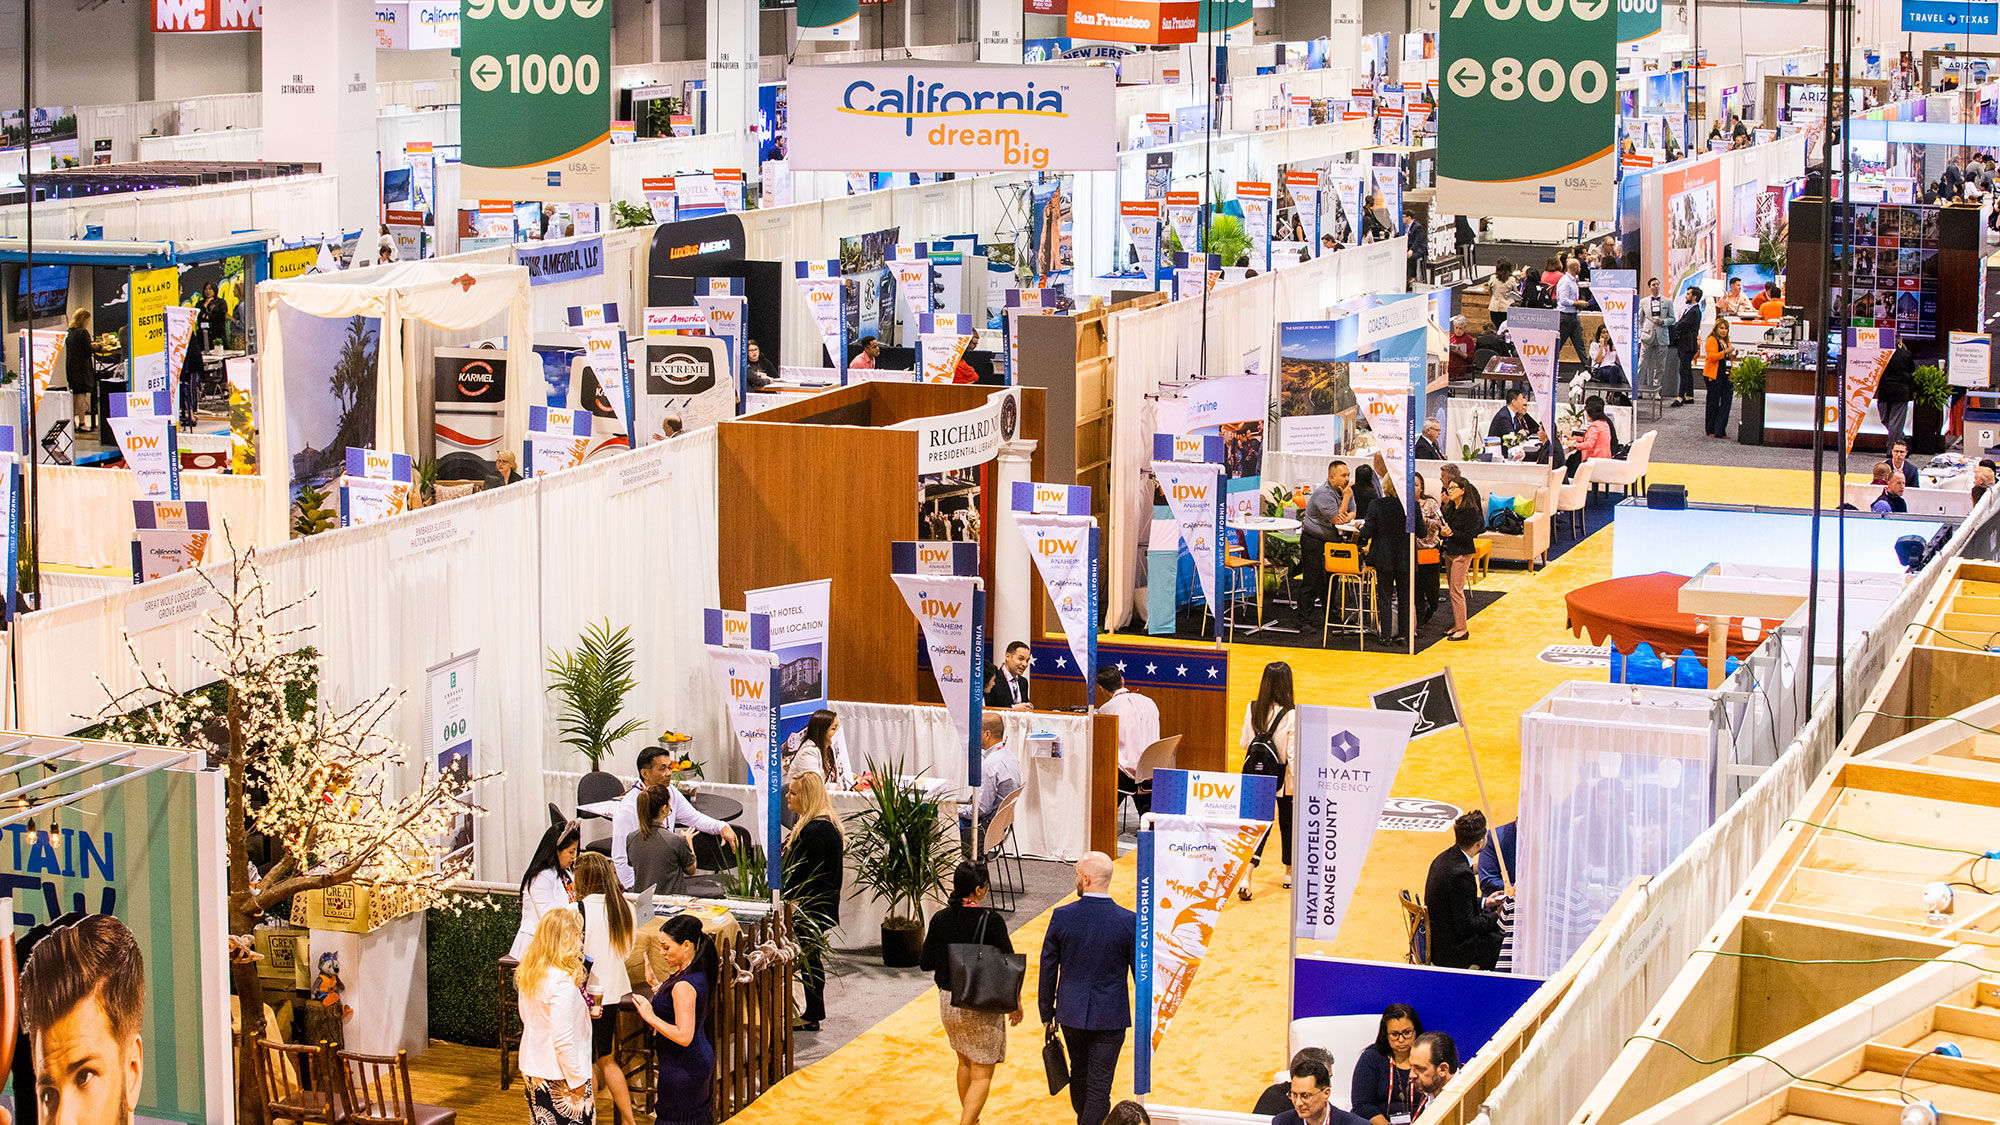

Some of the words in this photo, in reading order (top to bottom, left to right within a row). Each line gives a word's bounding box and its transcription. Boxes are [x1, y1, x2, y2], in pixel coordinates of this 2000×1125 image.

[1074, 12, 1095, 26] San
[1097, 13, 1150, 30] Francisco
[1162, 17, 1172, 29] San
[1173, 17, 1196, 29] Francisco
[1910, 13, 1944, 23] TRAVEL
[1959, 15, 1989, 24] TEXAS
[720, 53, 730, 61] FIRE
[1063, 48, 1091, 59] NEW
[292, 74, 303, 84] FIRE
[506, 54, 599, 95] 1000
[1489, 57, 1608, 104] 800
[281, 84, 315, 94] EXTINGUISHER
[843, 75, 1063, 136] California
[928, 124, 1020, 147] dream
[1003, 142, 1049, 169] big
[568, 163, 588, 172] USA
[1564, 178, 1588, 188] USA
[542, 251, 583, 275] AMERICA,
[584, 246, 599, 268] LLC
[138, 281, 171, 294] OAKLAND
[810, 291, 834, 303] ipw
[1605, 301, 1627, 312] ipw
[648, 314, 667, 323] Tour
[711, 310, 735, 322] ipw
[148, 328, 162, 339] 2019
[1858, 331, 1877, 340] ipw
[588, 339, 613, 351] ipw
[1523, 344, 1549, 357] ipw
[654, 364, 706, 374] EXTREME
[148, 377, 165, 389] BEST
[458, 373, 494, 383] KARMEL
[129, 397, 151, 408] ipw
[1197, 401, 1218, 412] irvine
[1369, 402, 1399, 416] ipw
[549, 413, 571, 424] ipw
[930, 419, 989, 447] RICHARD
[127, 435, 159, 451] ipw
[1176, 440, 1200, 451] ipw
[928, 446, 977, 462] PRESIDENTIAL
[367, 457, 389, 468] ipw
[1037, 490, 1065, 503] ipw
[1173, 485, 1207, 500] ipw
[157, 507, 182, 520] ipw
[1039, 538, 1078, 556] ipw
[919, 550, 949, 563] ipw
[144, 600, 160, 612] GREAT
[160, 596, 173, 608] WOLF
[174, 593, 190, 604] LODGE
[921, 599, 962, 619] ipw
[158, 607, 174, 619] GROVE
[174, 600, 198, 615] ANAHEIM
[777, 605, 804, 617] HOTELS,
[725, 619, 748, 634] ipw
[786, 620, 823, 633] LOCATION
[932, 622, 963, 630] ANAHEIM
[930, 645, 966, 656] California
[974, 624, 983, 678] CALIFORNIA
[730, 678, 764, 700] ipw
[1318, 767, 1371, 782] HYATT
[1192, 782, 1235, 801] ipw
[1318, 780, 1371, 793] REGENCY
[1204, 802, 1237, 810] ANAHEIM
[1309, 796, 1320, 815] OF
[1325, 798, 1337, 861] COUNTY
[1168, 842, 1217, 856] California
[1307, 820, 1320, 876] HOTELS
[325, 884, 352, 897] GREAT
[1323, 865, 1336, 926] ORANGE
[1306, 879, 1319, 926] HYATT
[326, 909, 352, 917] LODGE
[1141, 877, 1149, 948] CALIFORNIA
[1140, 952, 1148, 981] VISIT
